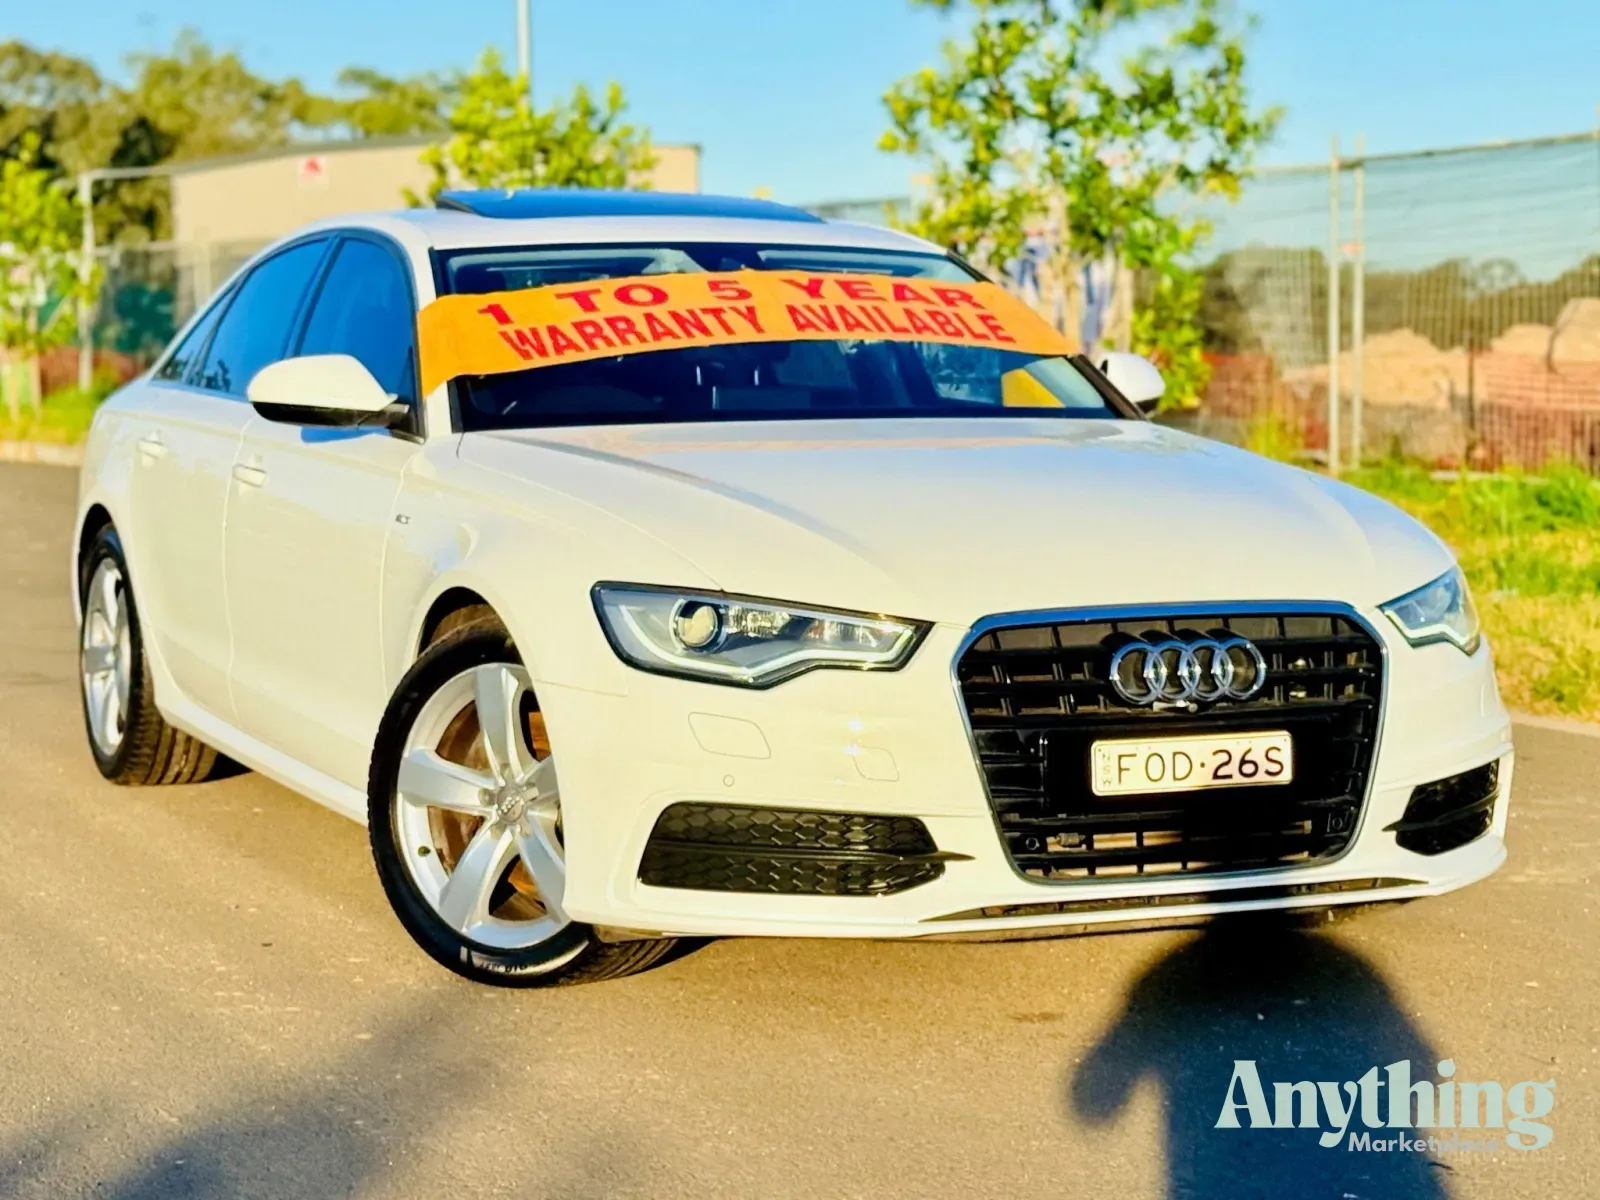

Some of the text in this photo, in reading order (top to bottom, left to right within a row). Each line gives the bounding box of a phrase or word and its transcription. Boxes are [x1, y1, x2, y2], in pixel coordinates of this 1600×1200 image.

[478, 278, 987, 325] 1 TO 5 YEAR
[498, 304, 1017, 361] WARRANTY AVAILABLE
